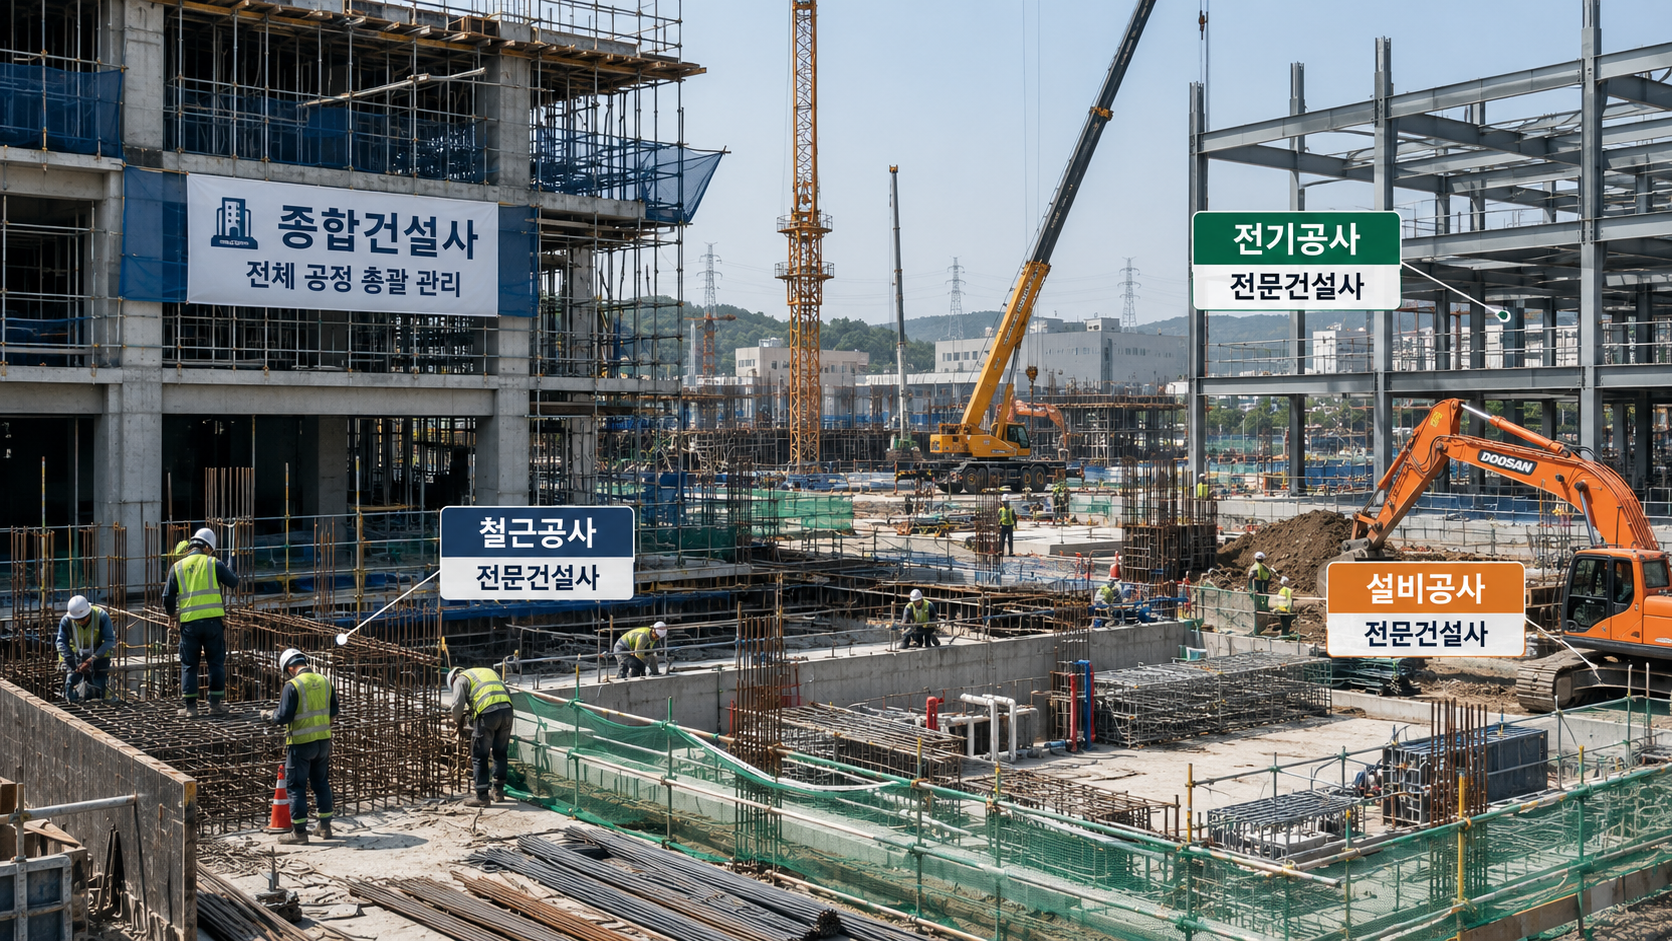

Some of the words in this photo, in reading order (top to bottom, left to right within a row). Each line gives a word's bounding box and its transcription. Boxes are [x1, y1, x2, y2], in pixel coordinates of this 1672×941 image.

[278, 204, 478, 260] 종합건설사
[246, 261, 295, 290] 전체
[304, 264, 352, 293] 공정
[360, 266, 409, 296] 총괄
[416, 270, 461, 298] 관리
[1480, 451, 1533, 473] DOOSAN
